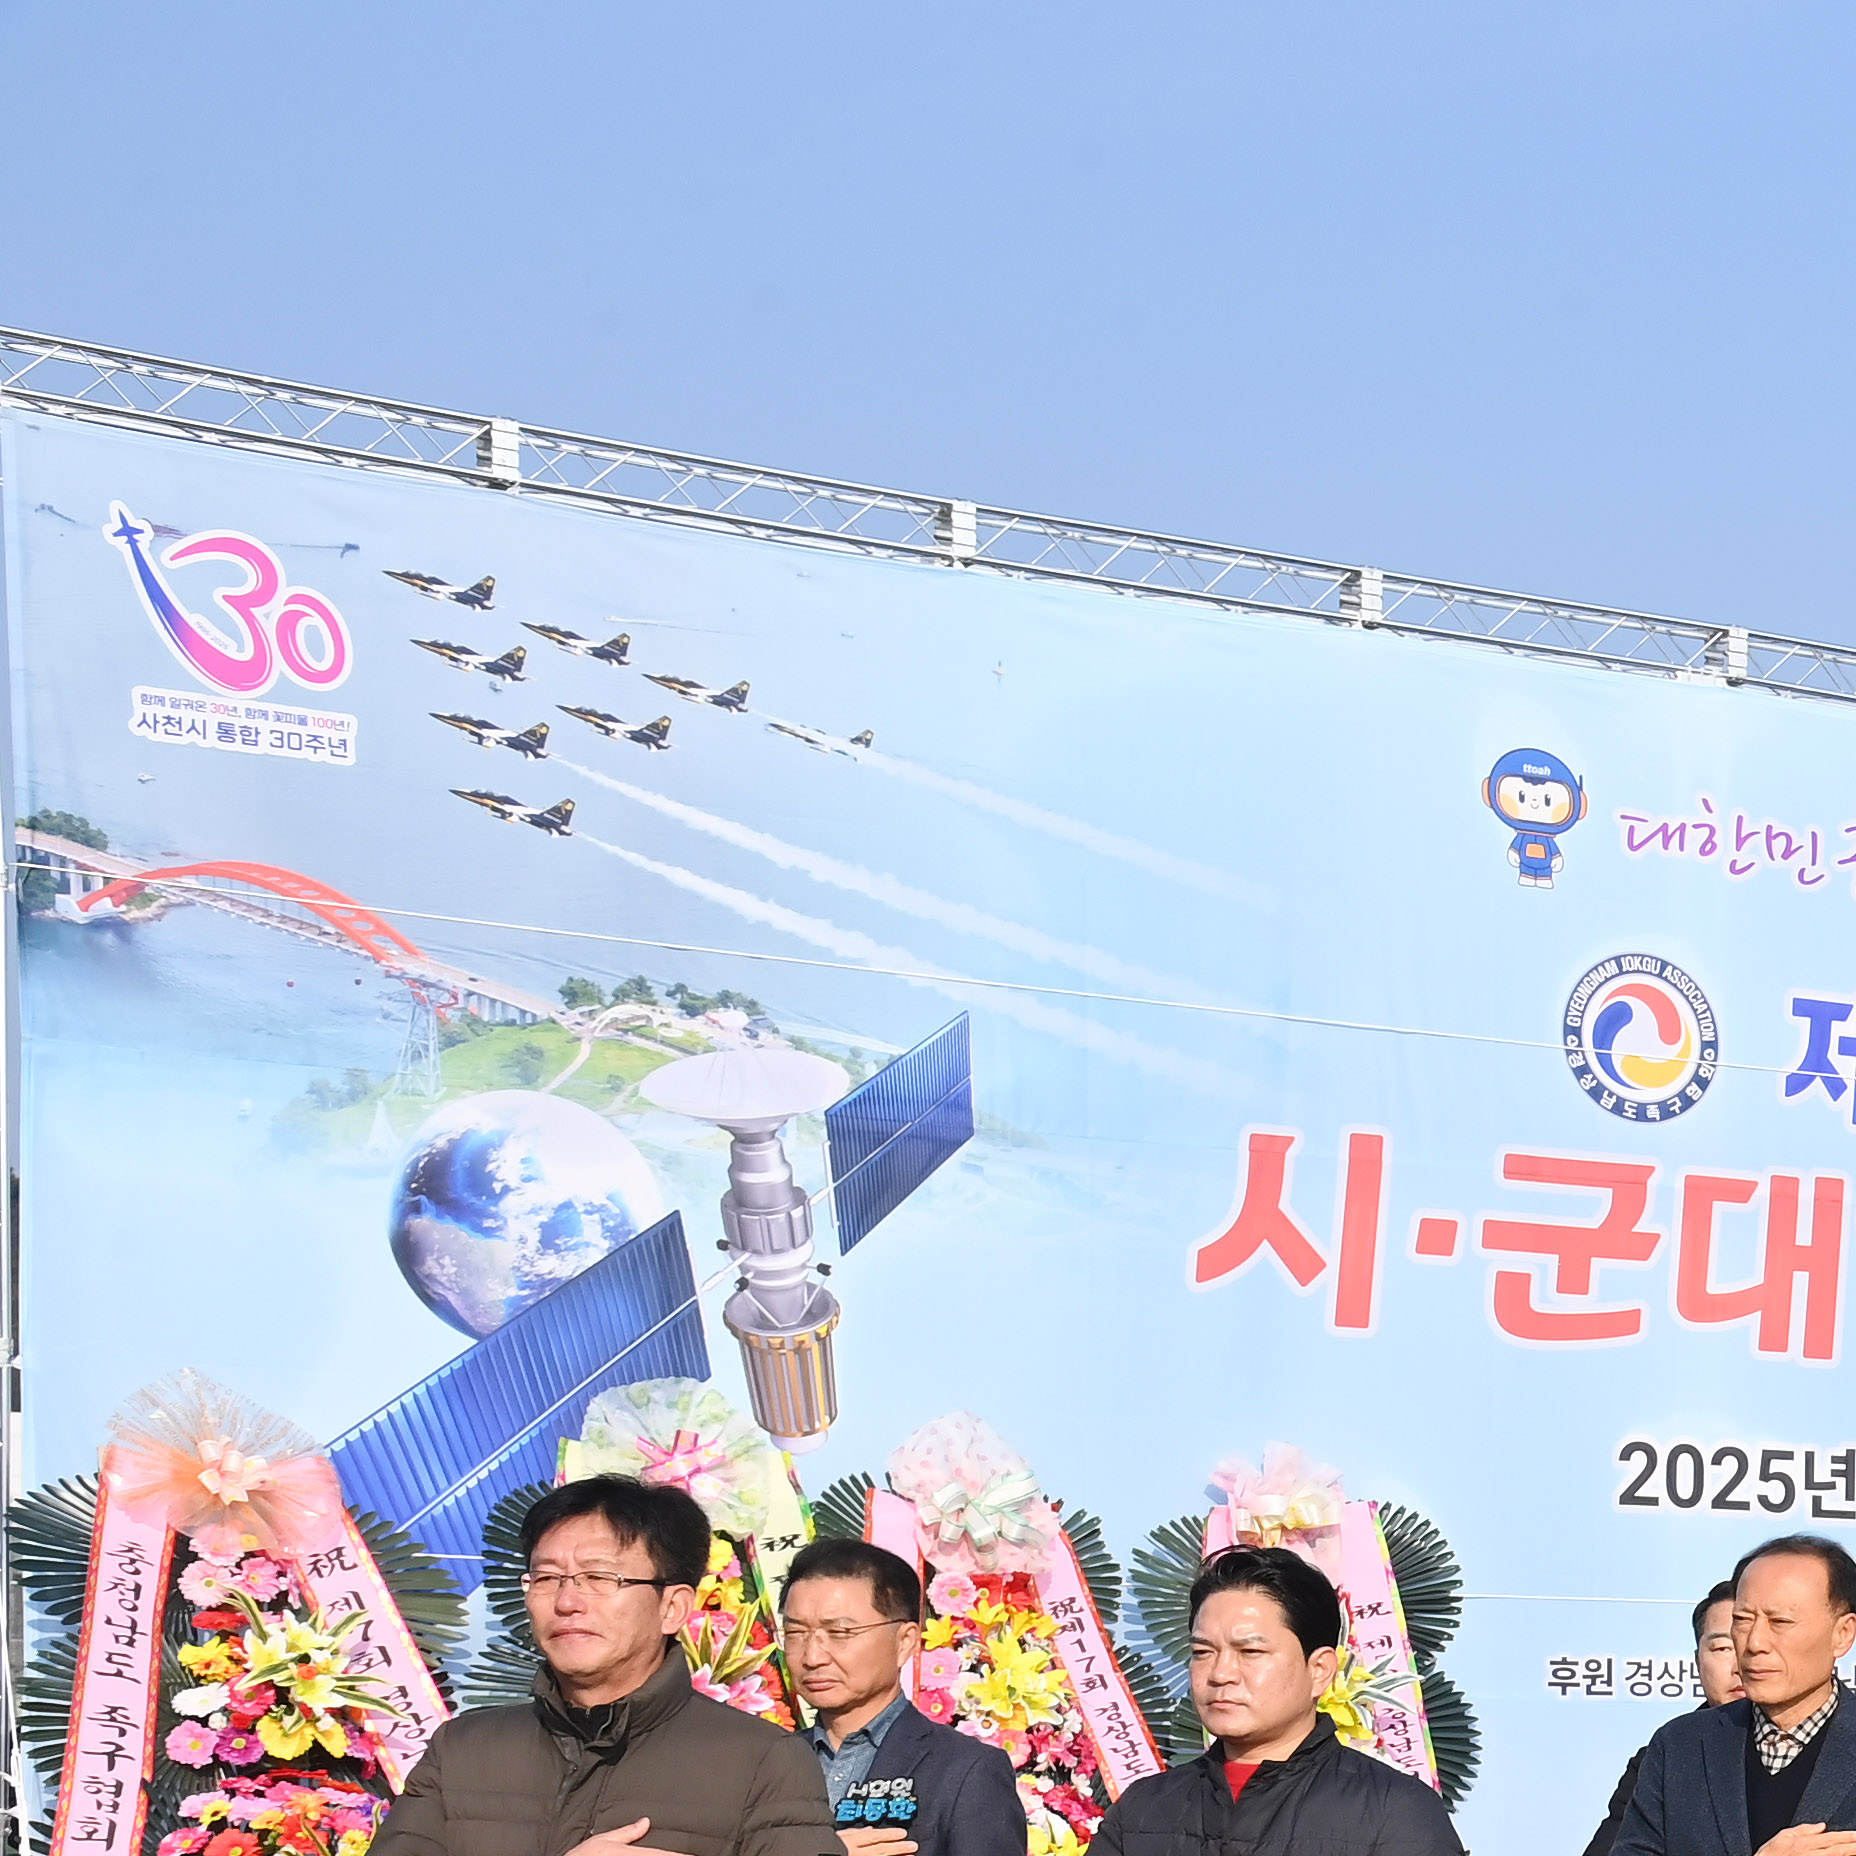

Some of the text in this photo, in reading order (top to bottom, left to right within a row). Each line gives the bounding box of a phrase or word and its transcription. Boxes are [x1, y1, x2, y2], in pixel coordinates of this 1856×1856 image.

[137, 712, 348, 758] 사천시 통합 30주년
[140, 693, 165, 707] 함께
[244, 707, 269, 722] 함께
[1567, 956, 1715, 1042] GYEONGNAM JOKGU ASSOCIATION
[308, 1546, 358, 1578] 祝
[92, 1540, 155, 1686] 충청남도
[1547, 1656, 1613, 1696] 후원
[1094, 1701, 1154, 1781] 경상남도
[71, 1704, 140, 1851] 족구협회
